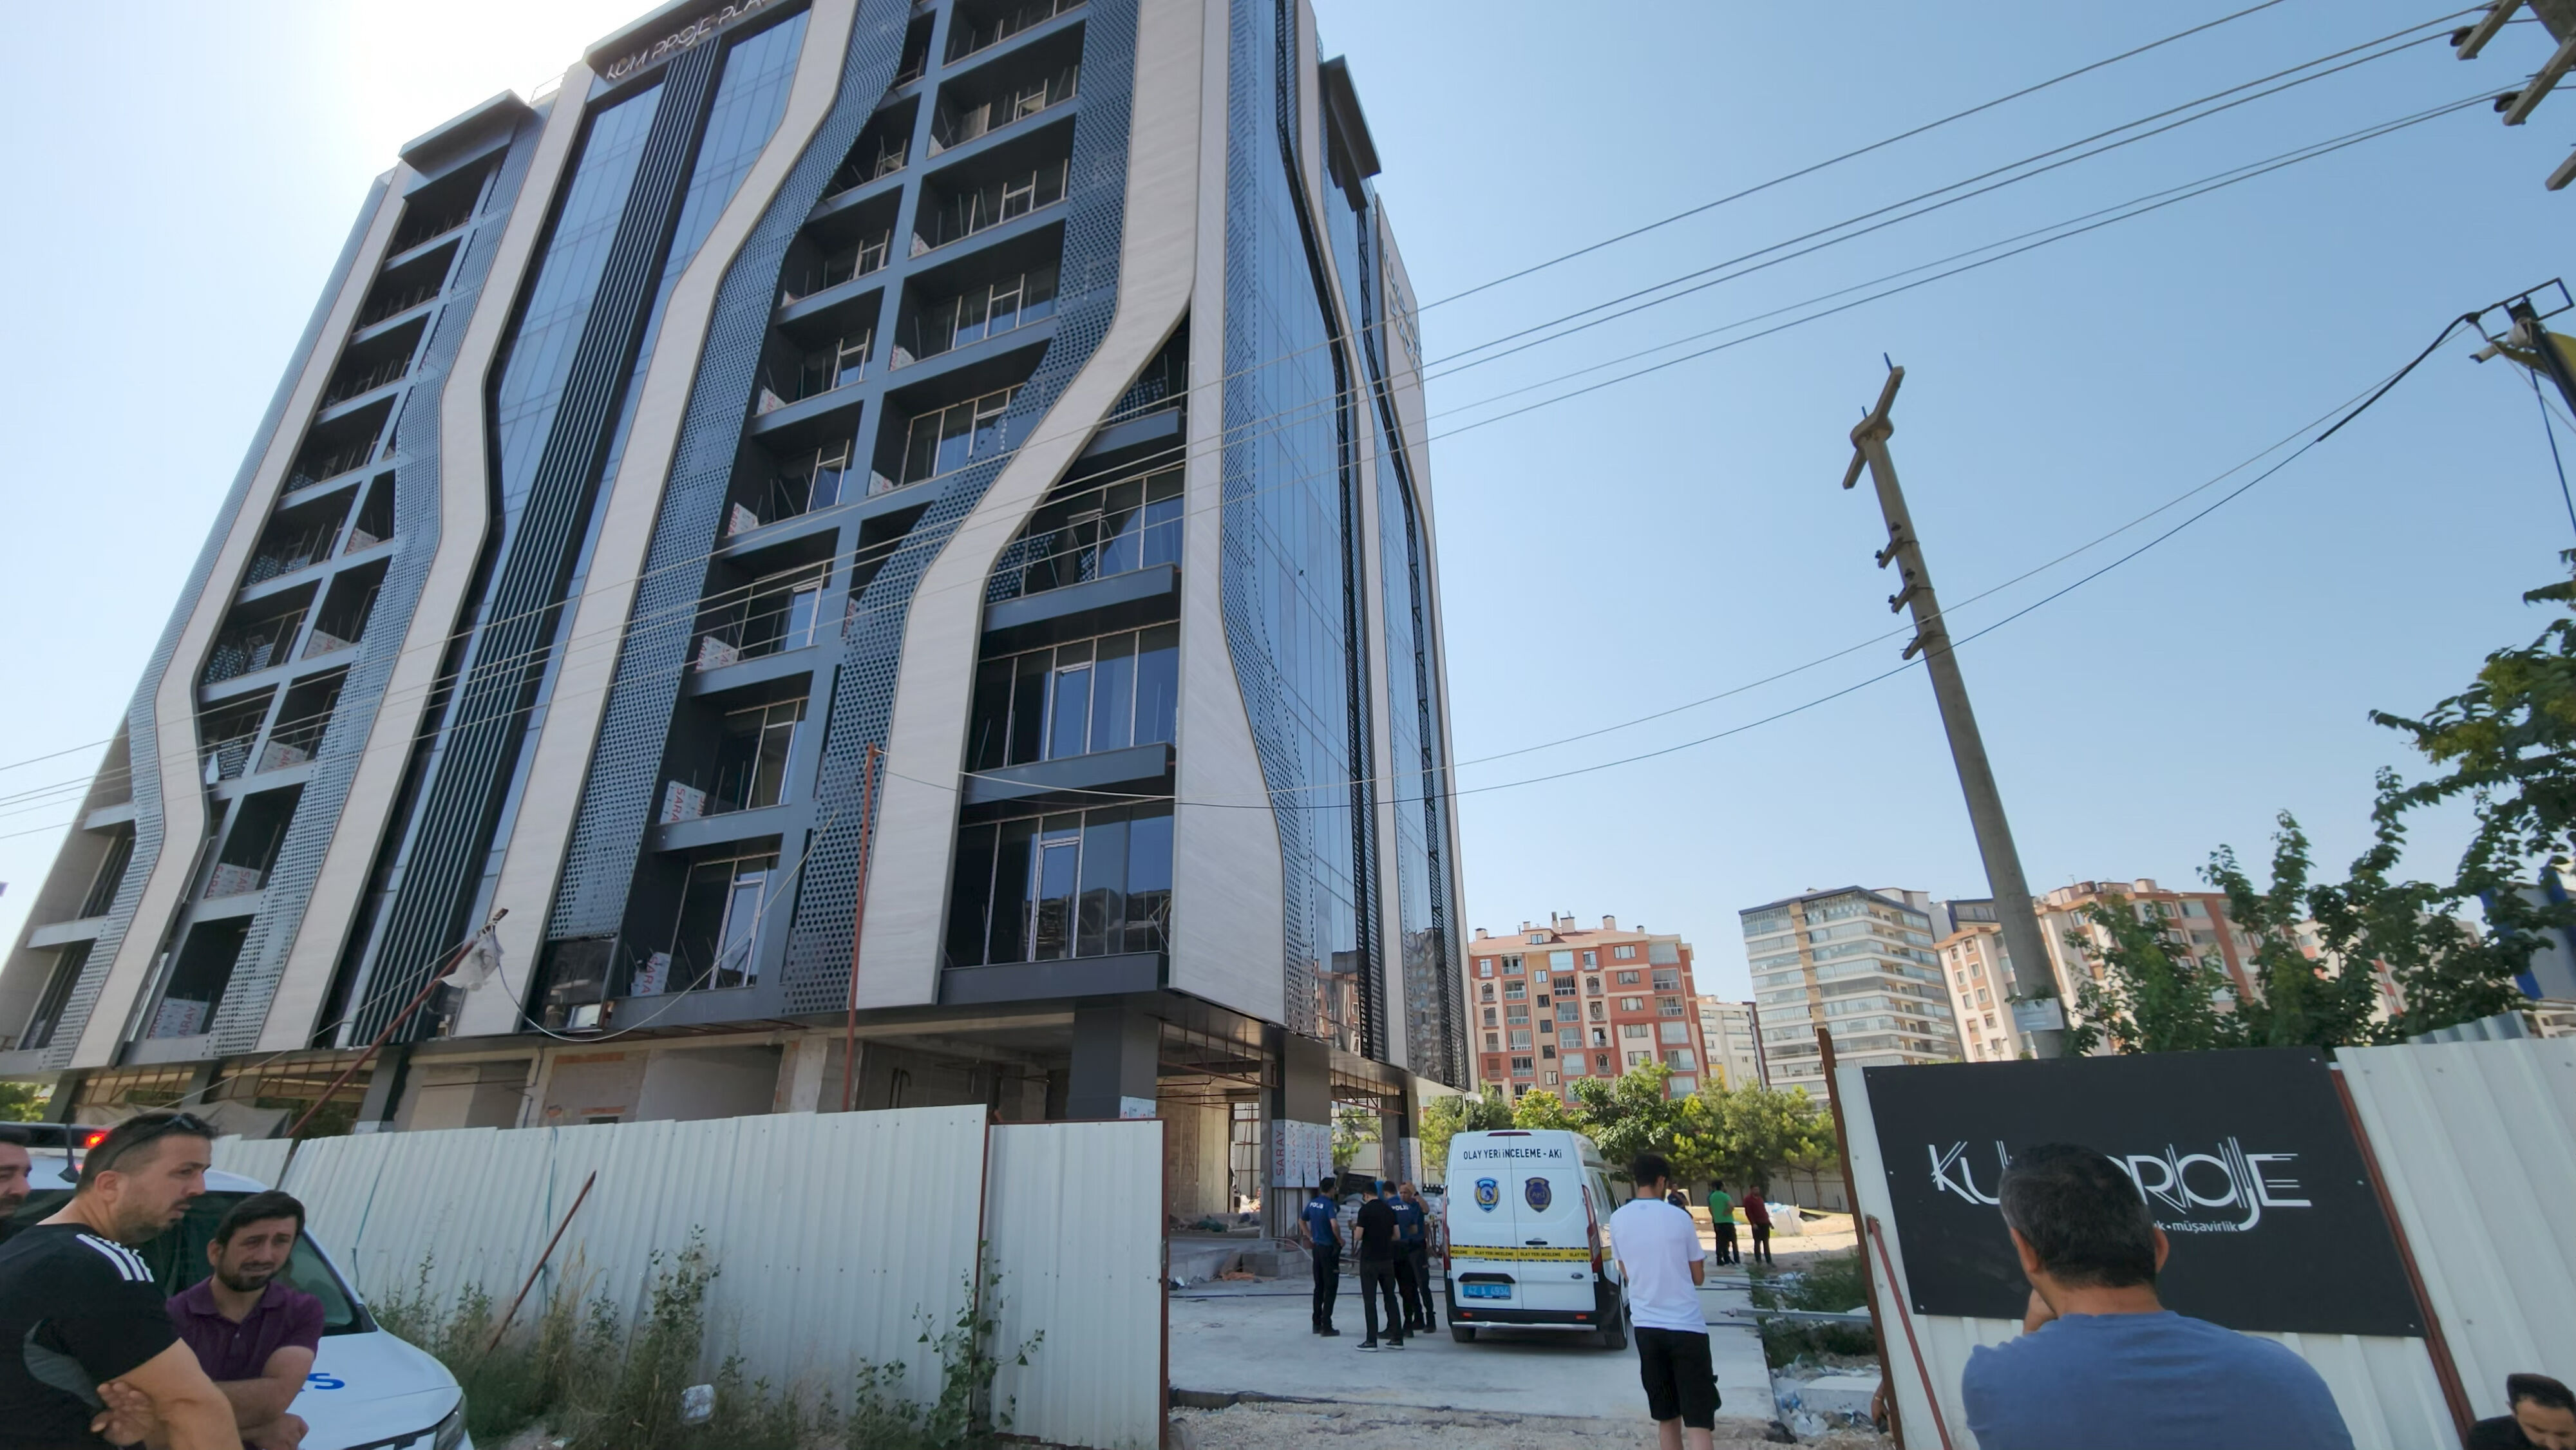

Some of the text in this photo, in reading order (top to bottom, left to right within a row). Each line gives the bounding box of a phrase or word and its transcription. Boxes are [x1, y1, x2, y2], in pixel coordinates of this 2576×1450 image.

[718, 0, 768, 25] PLA
[1276, 1129, 1285, 1176] SARAY
[1463, 1150, 1482, 1160] OLAY
[1928, 1140, 2013, 1205] KU
[2106, 1137, 2313, 1231] ROJE
[2172, 1220, 2239, 1234] müşavirlik
